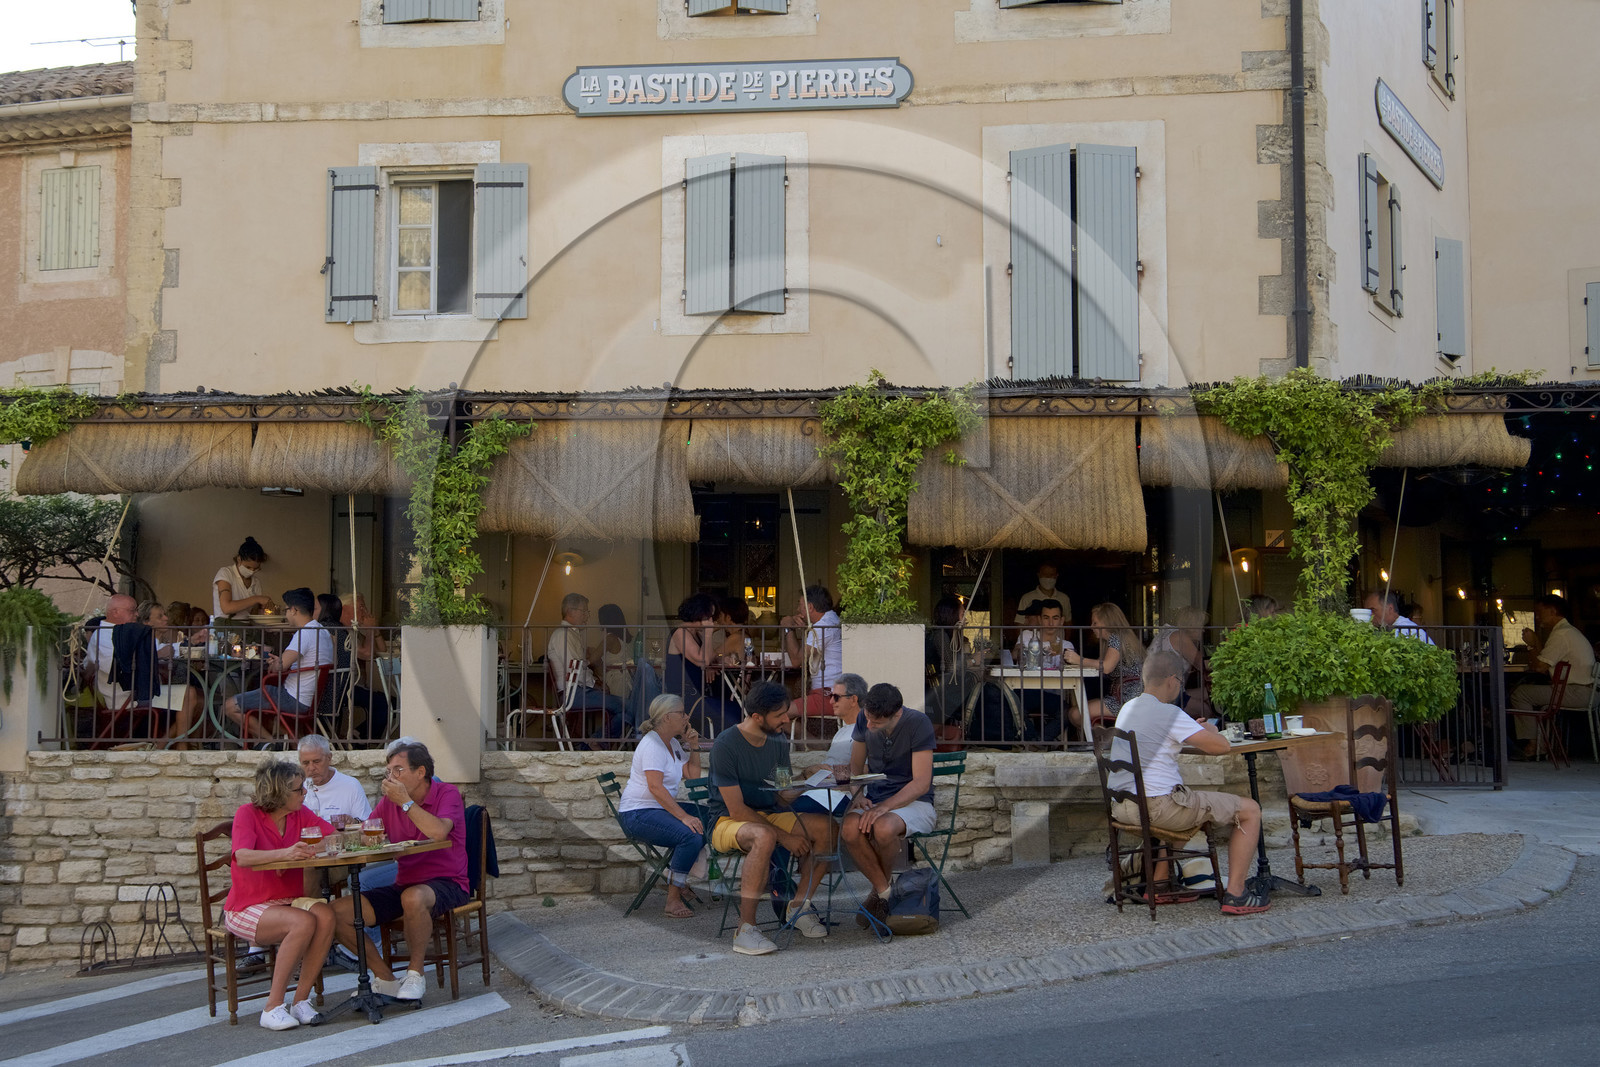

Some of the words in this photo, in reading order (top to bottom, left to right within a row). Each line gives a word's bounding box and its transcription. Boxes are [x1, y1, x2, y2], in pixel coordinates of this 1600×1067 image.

[580, 75, 601, 93] LA
[606, 71, 736, 105] BASTIDE
[742, 71, 764, 88] DE
[769, 66, 896, 100] PIERRES
